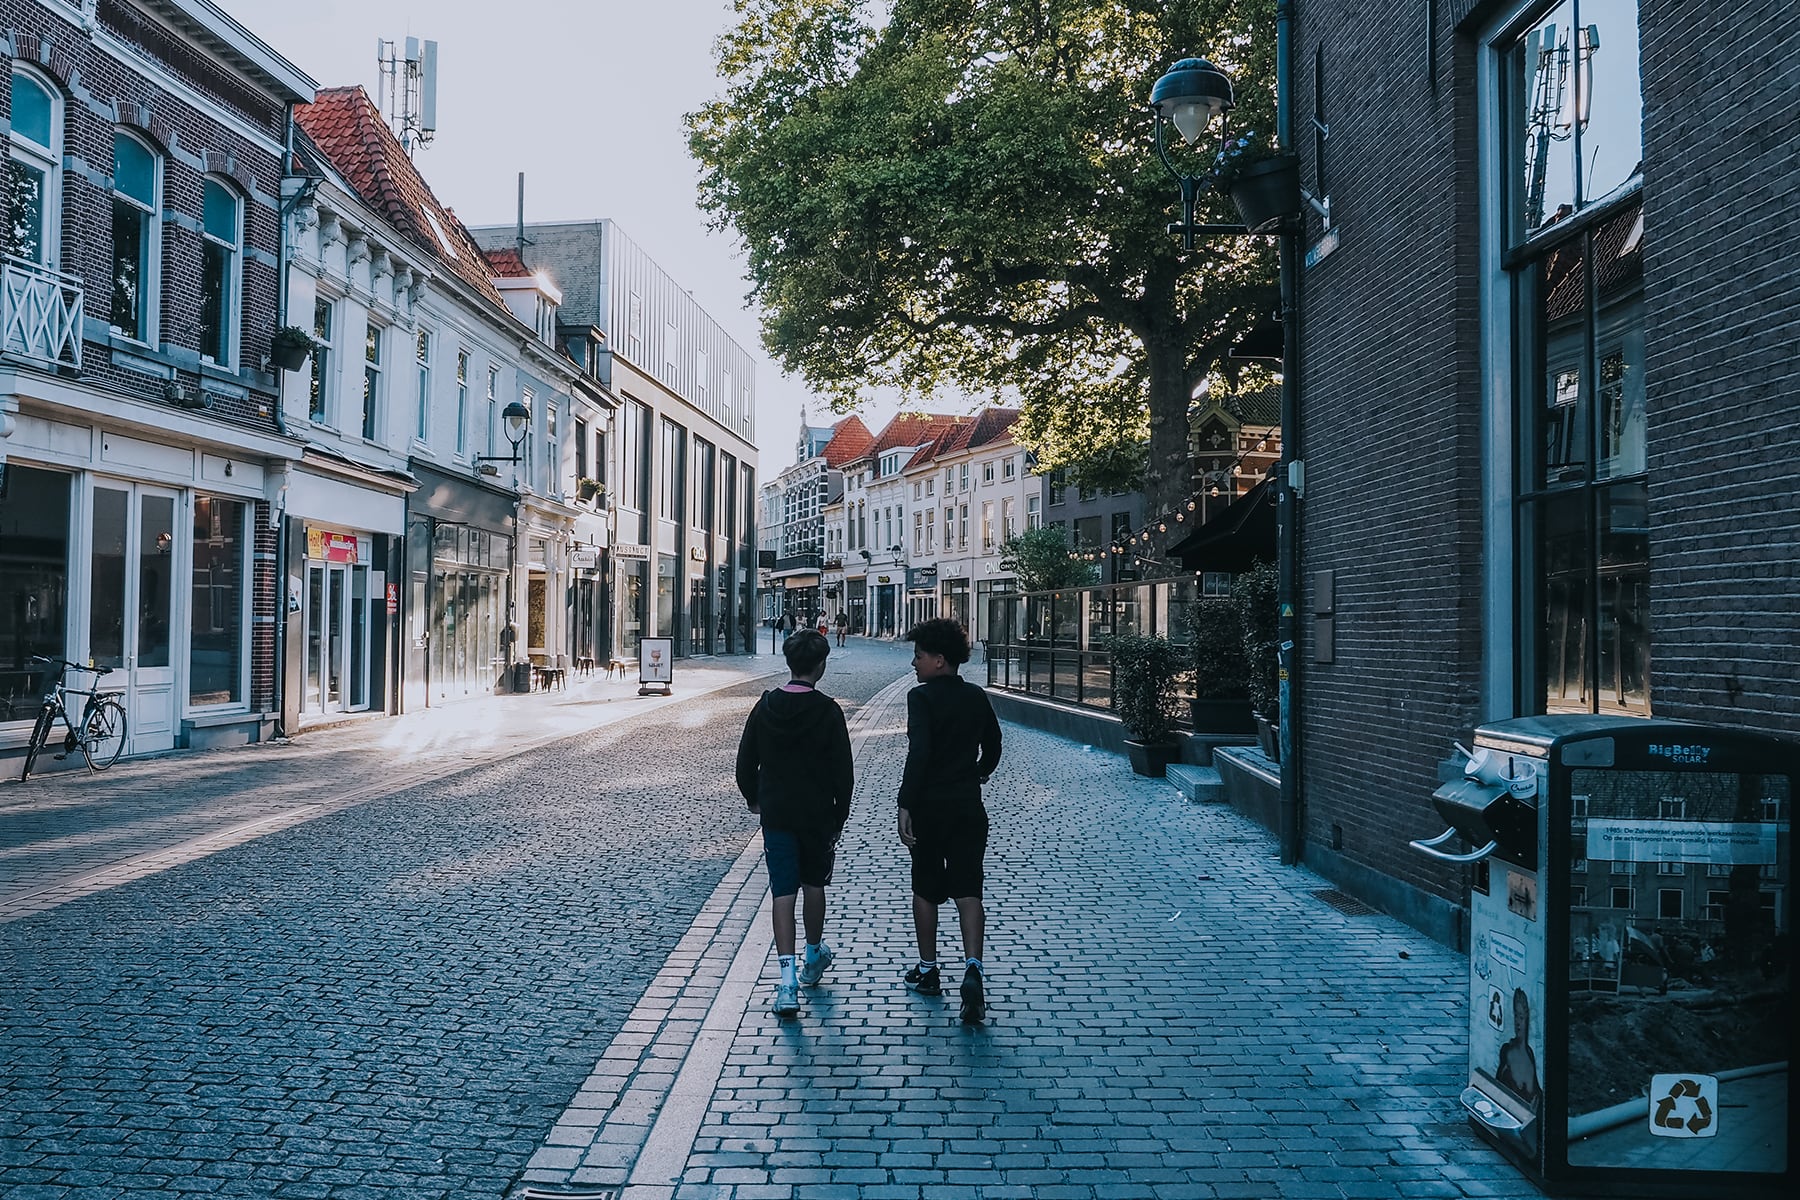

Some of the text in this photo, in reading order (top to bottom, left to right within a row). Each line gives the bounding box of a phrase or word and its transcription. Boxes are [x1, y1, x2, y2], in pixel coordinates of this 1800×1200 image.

[945, 565, 962, 577] ONLY
[985, 561, 1001, 574] ONL
[1648, 744, 1711, 757] BigBelly
[1624, 836, 1662, 844] achtergrond
[1675, 837, 1706, 845] voormalig
